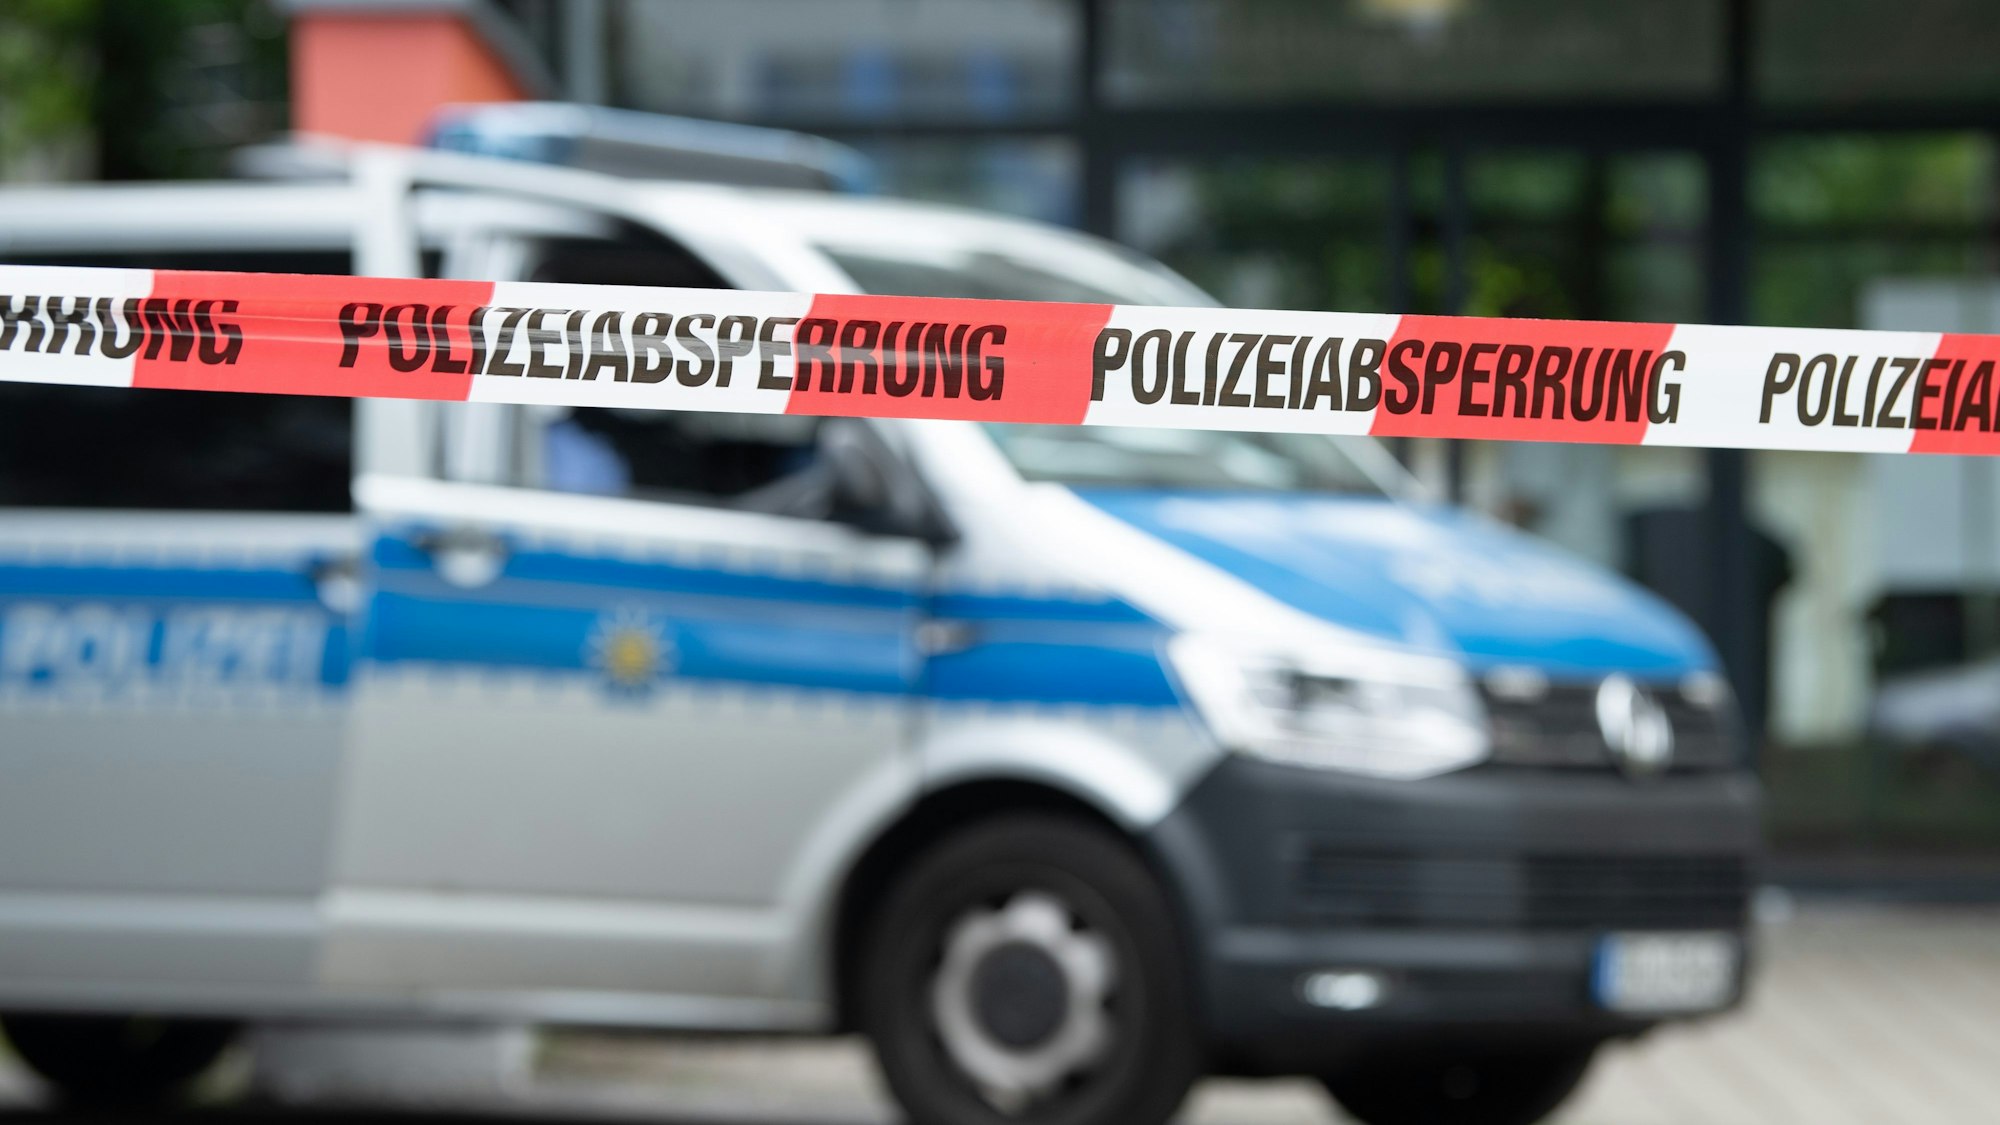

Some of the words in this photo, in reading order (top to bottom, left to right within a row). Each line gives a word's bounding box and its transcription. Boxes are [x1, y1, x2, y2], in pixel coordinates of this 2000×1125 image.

[338, 302, 1007, 401] POLIZEIABSPERRUNG
[1090, 328, 1686, 424] POLIZEIABSPERRUNG
[1759, 353, 2000, 432] POLIZEIA
